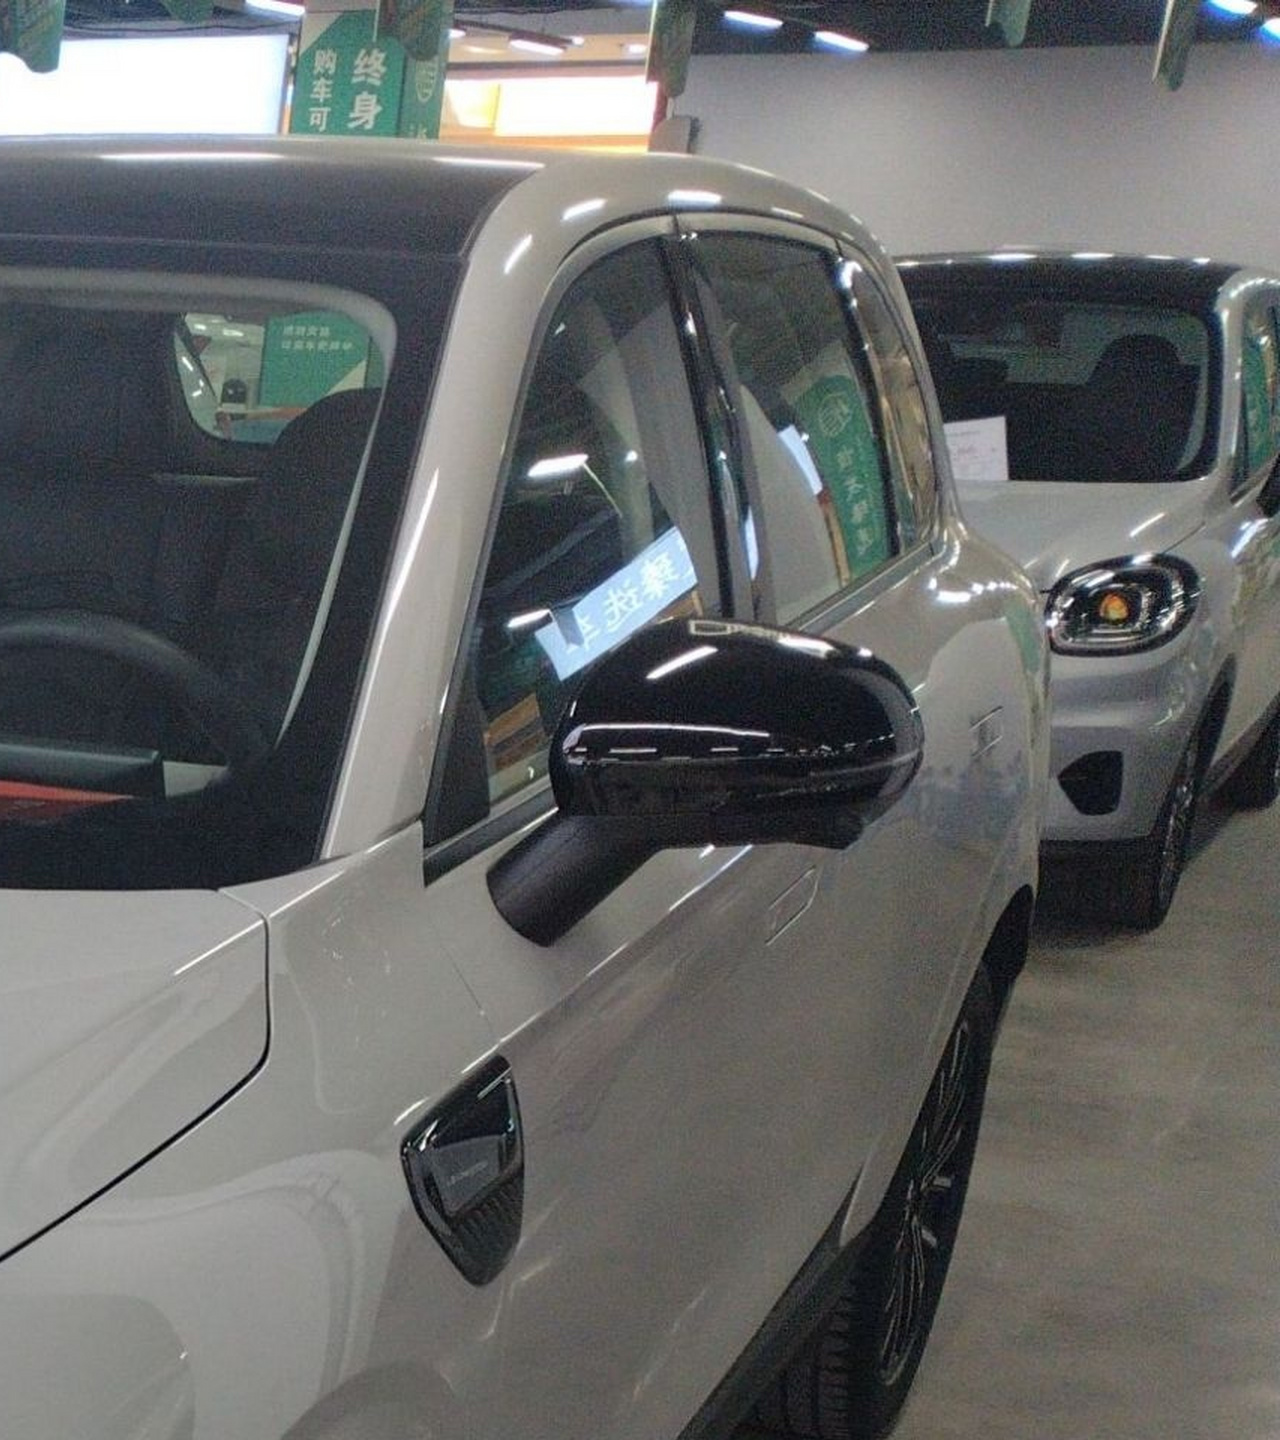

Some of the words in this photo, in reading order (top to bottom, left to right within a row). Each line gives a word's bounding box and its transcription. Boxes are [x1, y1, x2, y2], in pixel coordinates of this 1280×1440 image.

[308, 49, 337, 132] 购车可
[347, 48, 387, 129] 终身
